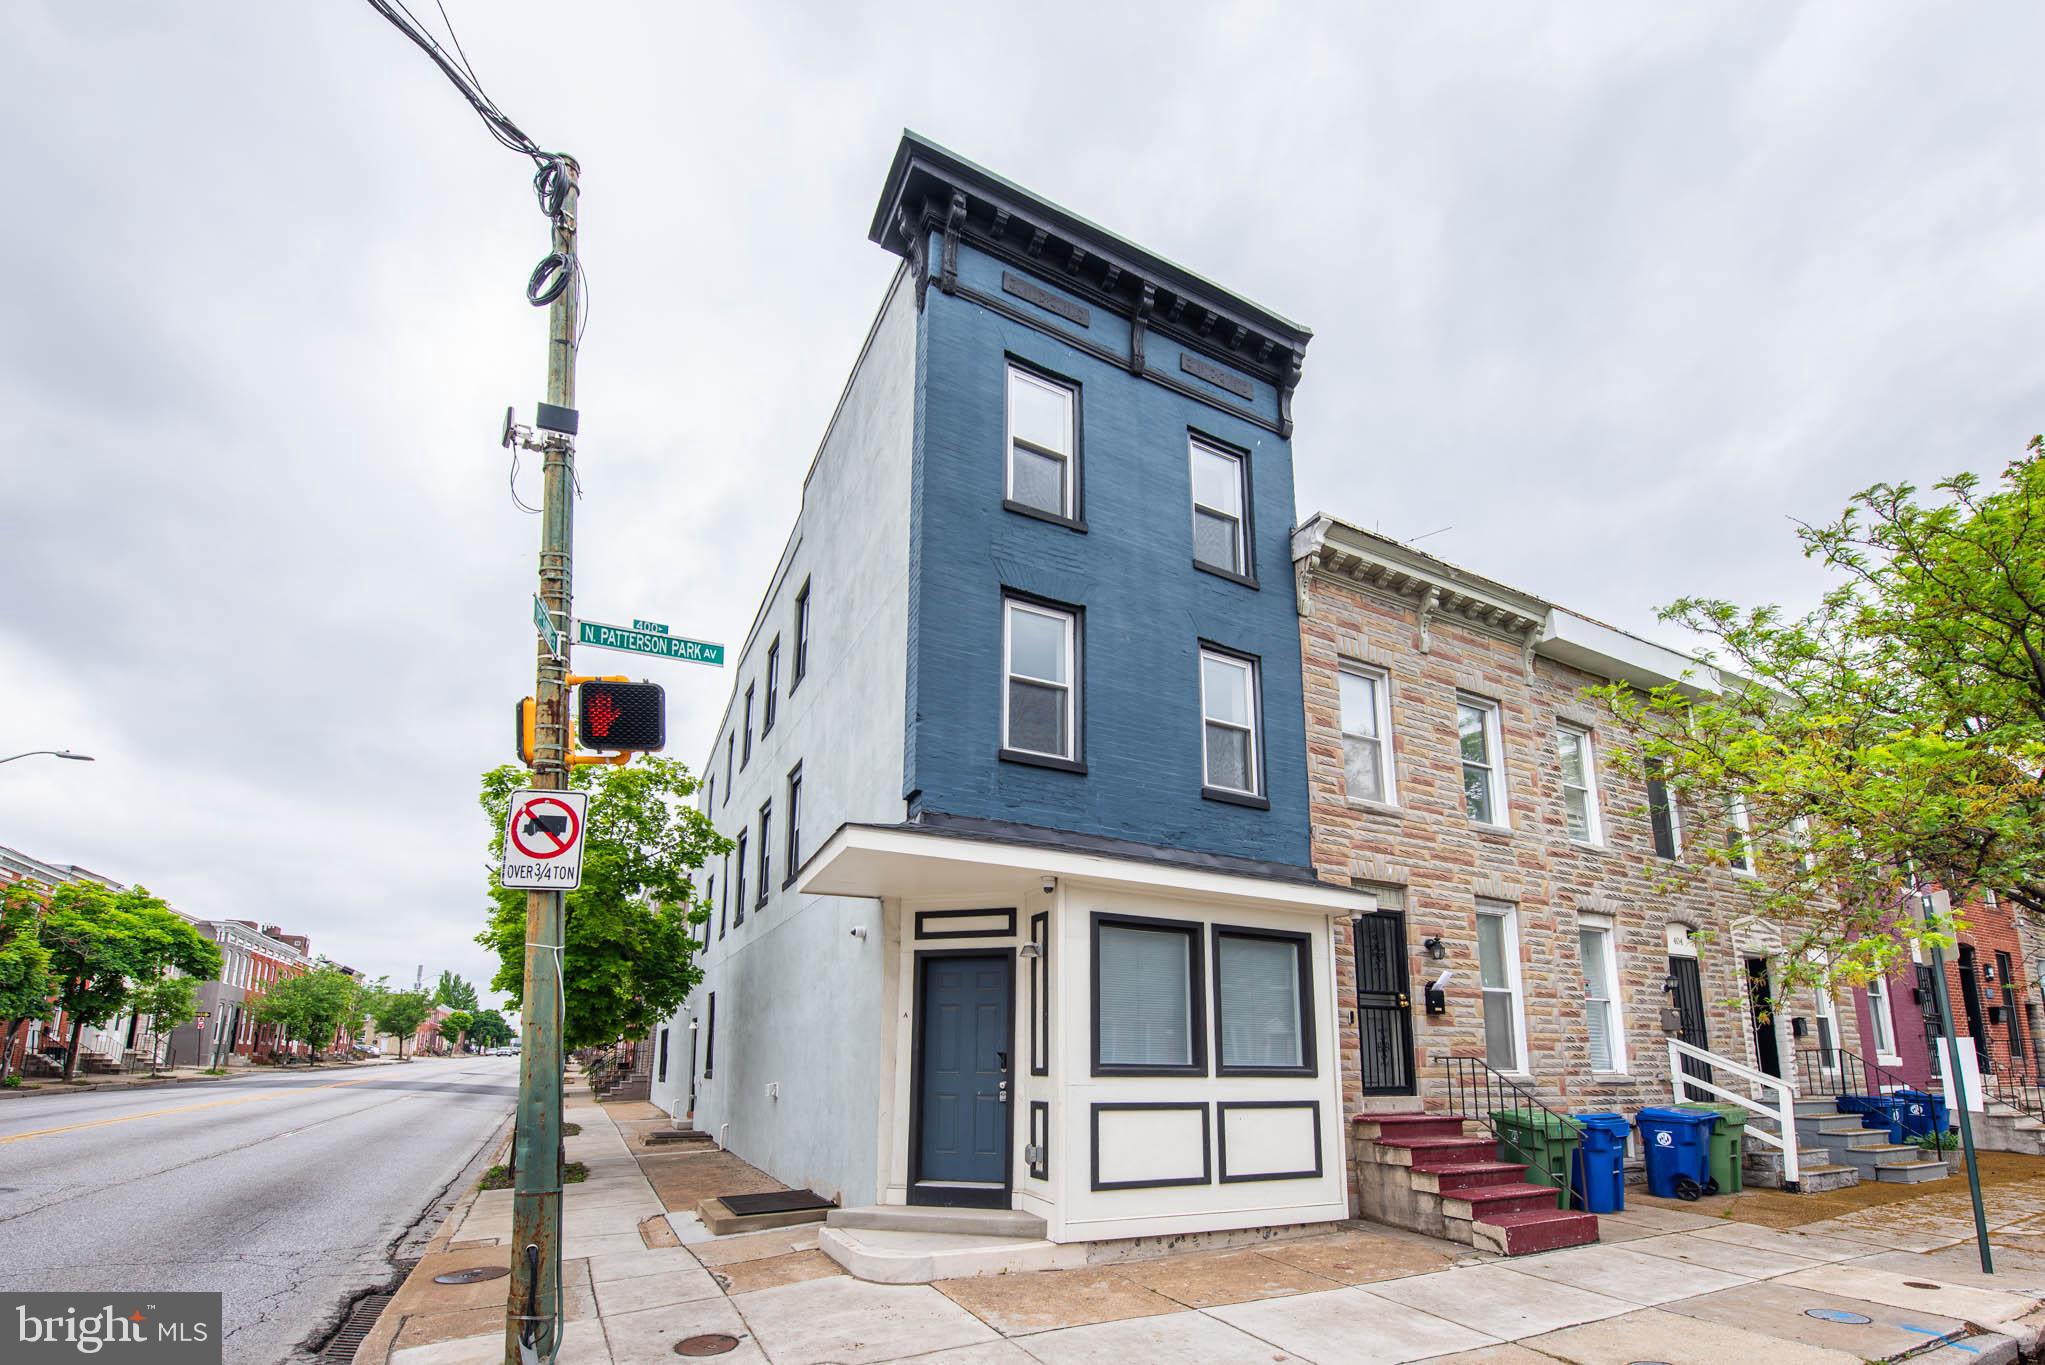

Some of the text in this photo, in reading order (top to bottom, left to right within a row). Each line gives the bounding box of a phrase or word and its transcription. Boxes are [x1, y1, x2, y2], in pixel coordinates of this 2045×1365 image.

[636, 621, 659, 632] 400
[585, 625, 717, 660] N. PATTERSON PARK AV
[507, 863, 575, 882] OVER 3/4 TON
